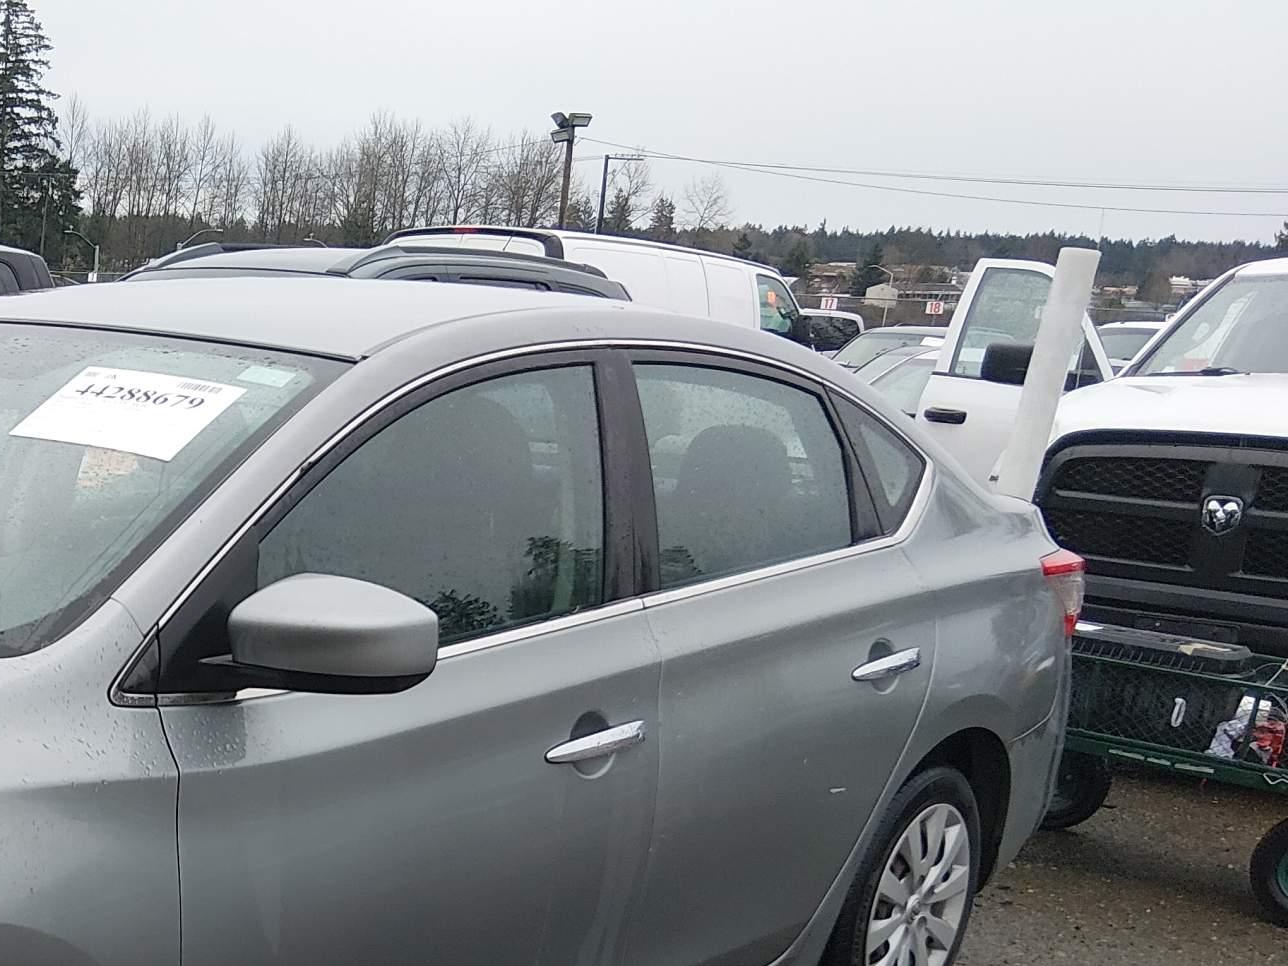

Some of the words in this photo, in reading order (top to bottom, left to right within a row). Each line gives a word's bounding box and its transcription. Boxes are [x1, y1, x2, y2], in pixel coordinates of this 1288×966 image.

[824, 299, 834, 309] 17
[928, 302, 941, 313] 18
[75, 383, 205, 409] 44288679
